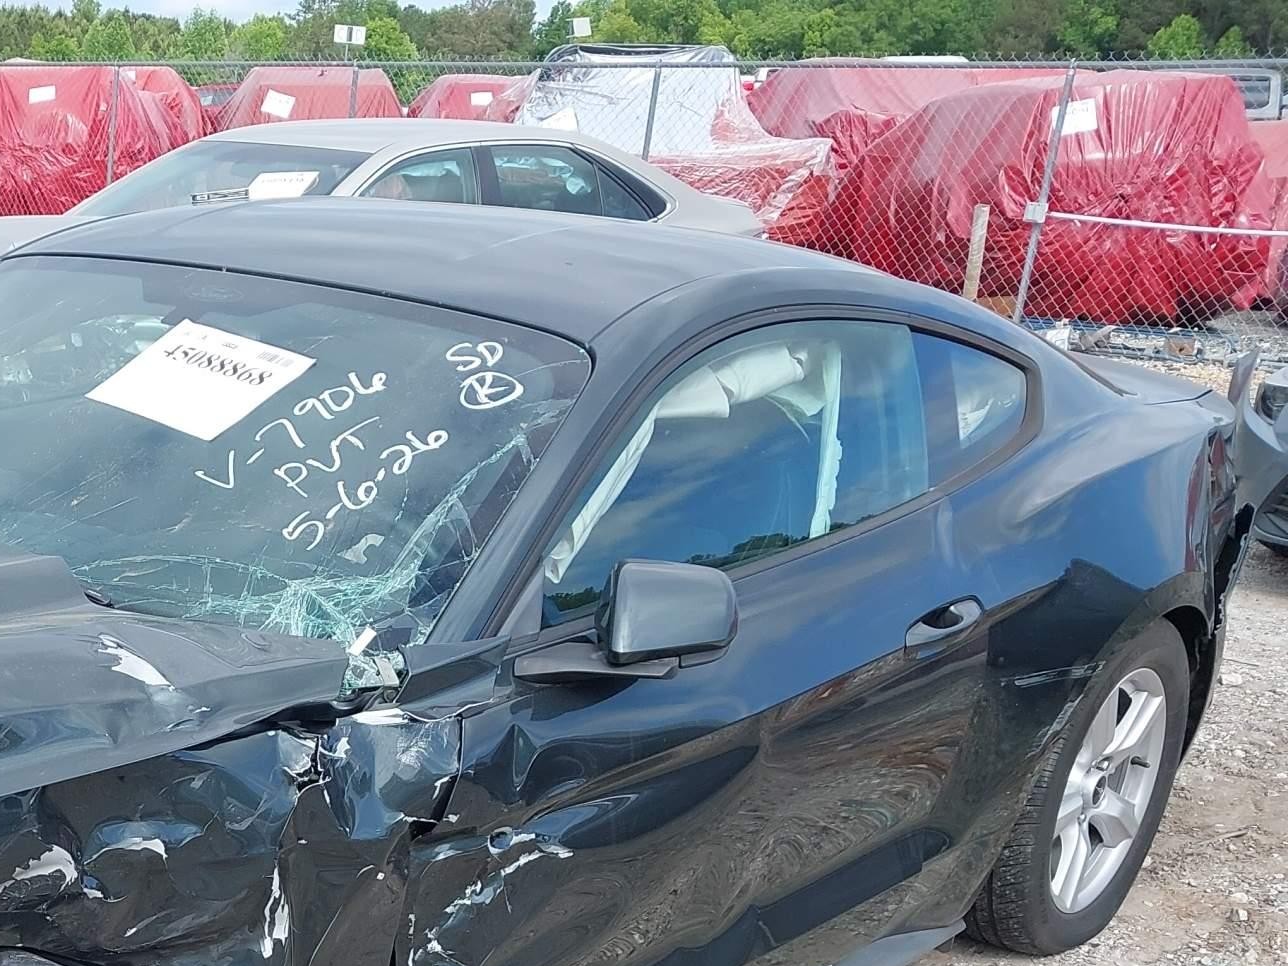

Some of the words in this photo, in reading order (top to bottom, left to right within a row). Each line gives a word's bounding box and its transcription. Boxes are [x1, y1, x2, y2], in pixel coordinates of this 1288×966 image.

[163, 344, 273, 386] 45088868
[445, 341, 504, 372] SD
[194, 371, 388, 489] V-7906
[273, 416, 381, 498] PVT
[281, 429, 450, 551] 5-6-26
